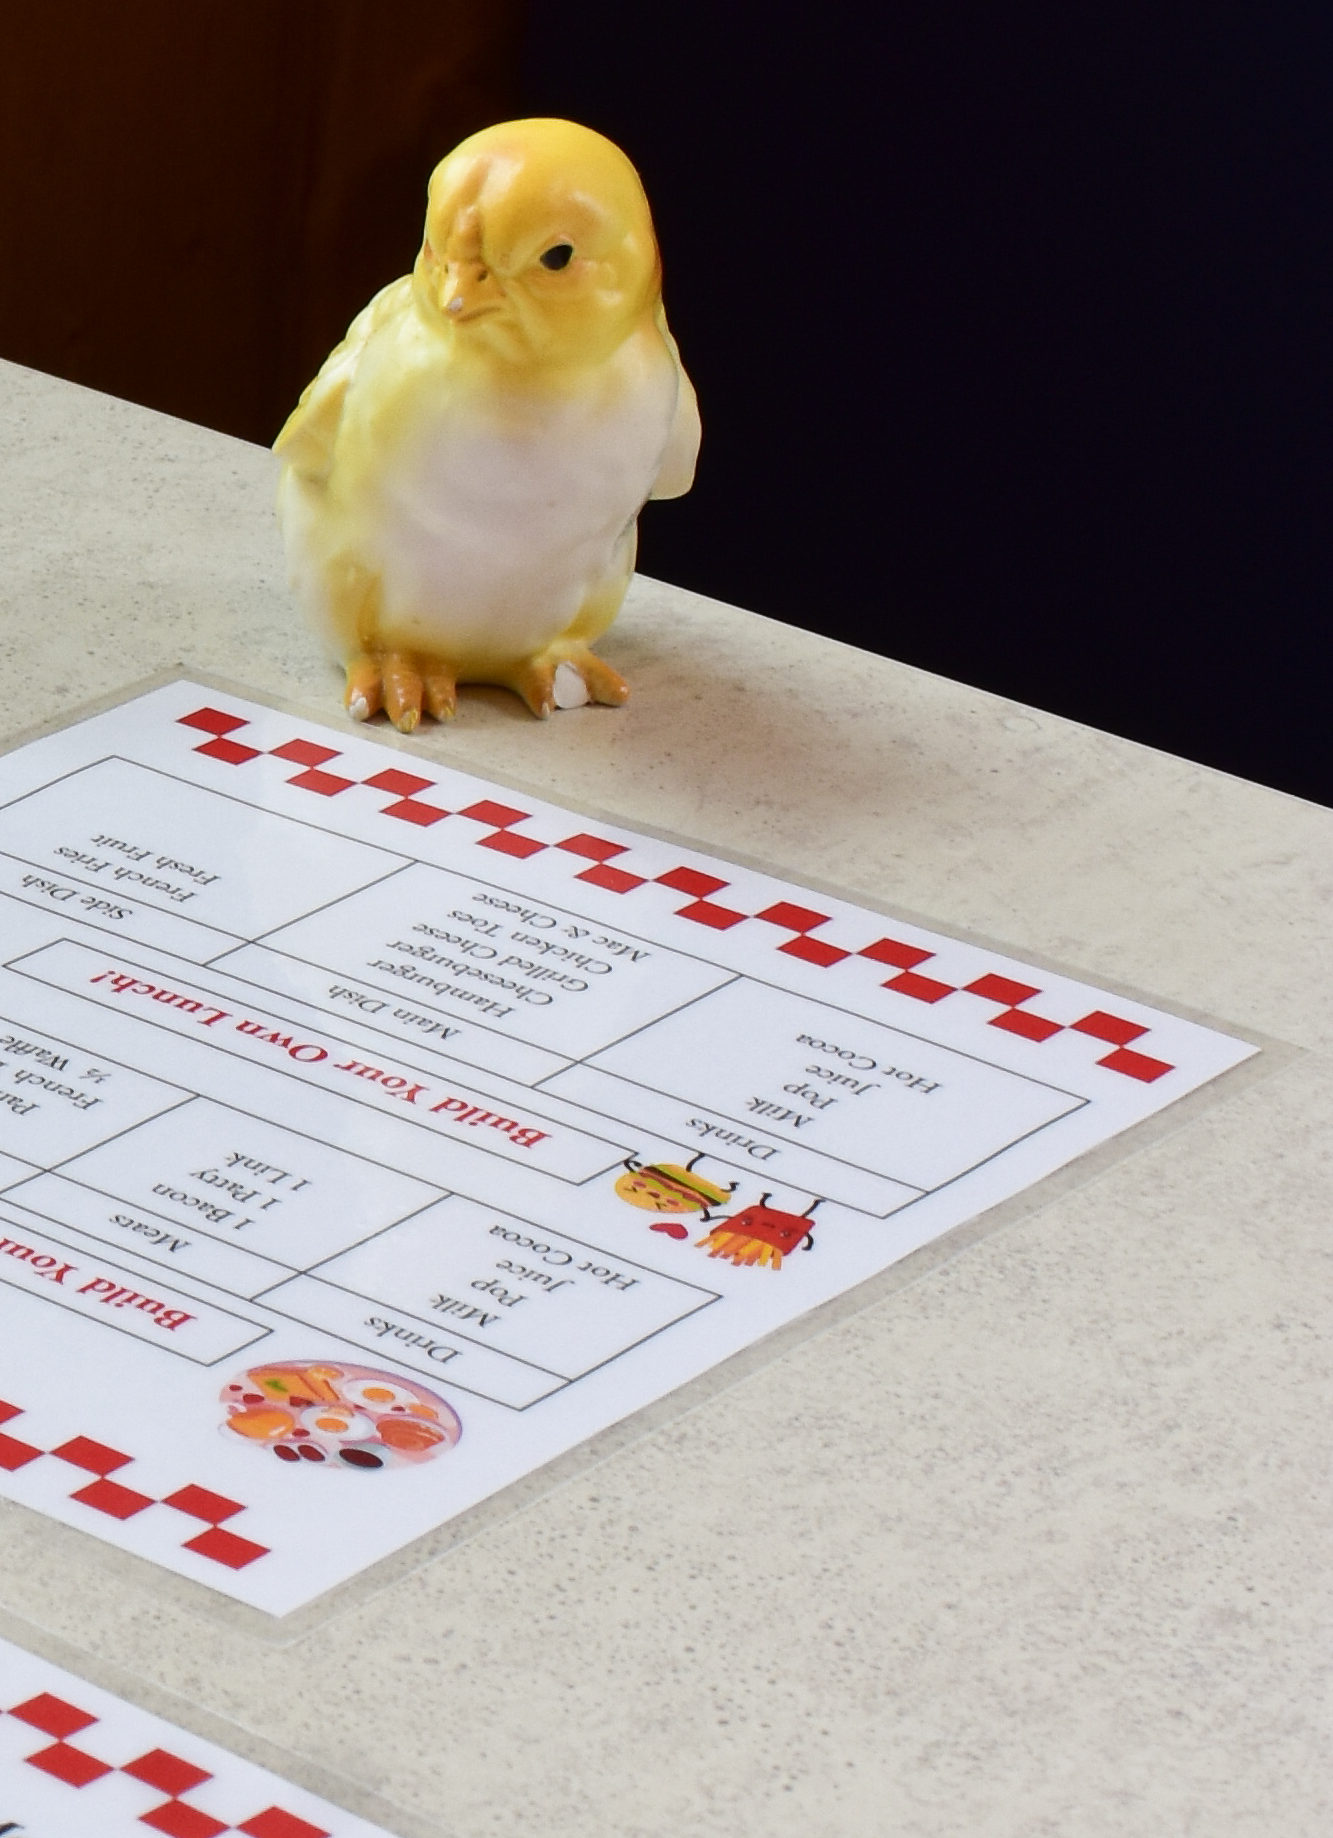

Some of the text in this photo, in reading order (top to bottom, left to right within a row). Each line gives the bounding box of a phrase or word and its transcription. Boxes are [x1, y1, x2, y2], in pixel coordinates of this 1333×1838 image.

[52, 845, 200, 905] French Fries
[90, 832, 223, 887] Fresh Fruit
[20, 874, 135, 922] Side Dish
[446, 909, 613, 975] Chicken Toes
[471, 892, 652, 963] Mac & Cheese
[385, 938, 554, 1006] Cheeseburger
[411, 922, 589, 993] Grilled Cheese
[328, 983, 464, 1041] Main Dish
[366, 958, 517, 1018] Hamburger
[89, 968, 553, 1150] Build Your Own Lunch!
[794, 1032, 944, 1095] Hot Cocoa
[804, 1063, 882, 1098] Juice
[14, 1068, 105, 1112] French
[743, 1095, 816, 1129] Milk
[782, 1081, 839, 1111] Pop
[684, 1117, 783, 1162] Drinks
[189, 1167, 285, 1212] 1 Patty
[223, 1150, 315, 1193] 1 Link
[151, 1182, 257, 1232] 1 Bacon
[109, 1213, 193, 1254] Meats
[487, 1223, 642, 1292] Hot Cocoa
[469, 1277, 530, 1308] Pop
[495, 1258, 576, 1294] Juice
[76, 1276, 199, 1333] Build
[429, 1291, 502, 1328] Milk
[363, 1315, 465, 1365] Drinks
